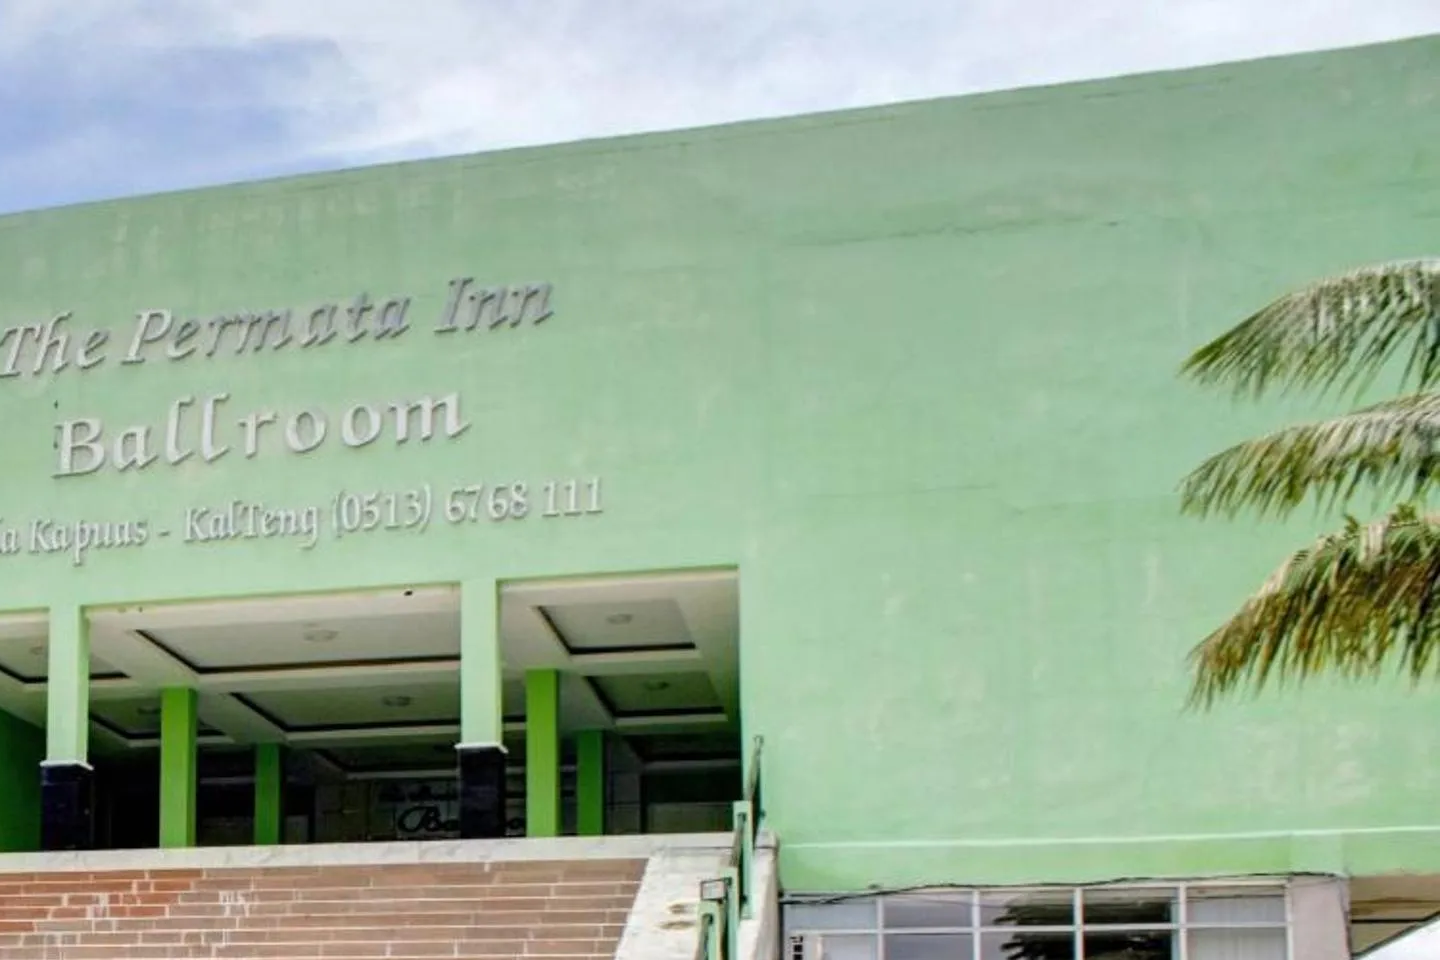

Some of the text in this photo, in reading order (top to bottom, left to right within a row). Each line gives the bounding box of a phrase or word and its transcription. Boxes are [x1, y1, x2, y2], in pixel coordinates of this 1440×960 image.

[119, 291, 411, 365] Permata
[433, 276, 553, 336] Inn
[51, 391, 472, 478] Ballroom
[27, 518, 149, 567] Kapuas
[183, 499, 320, 550] KalTeng
[331, 483, 432, 538] (0513)
[445, 479, 531, 525] 6768
[542, 475, 604, 518] 111
